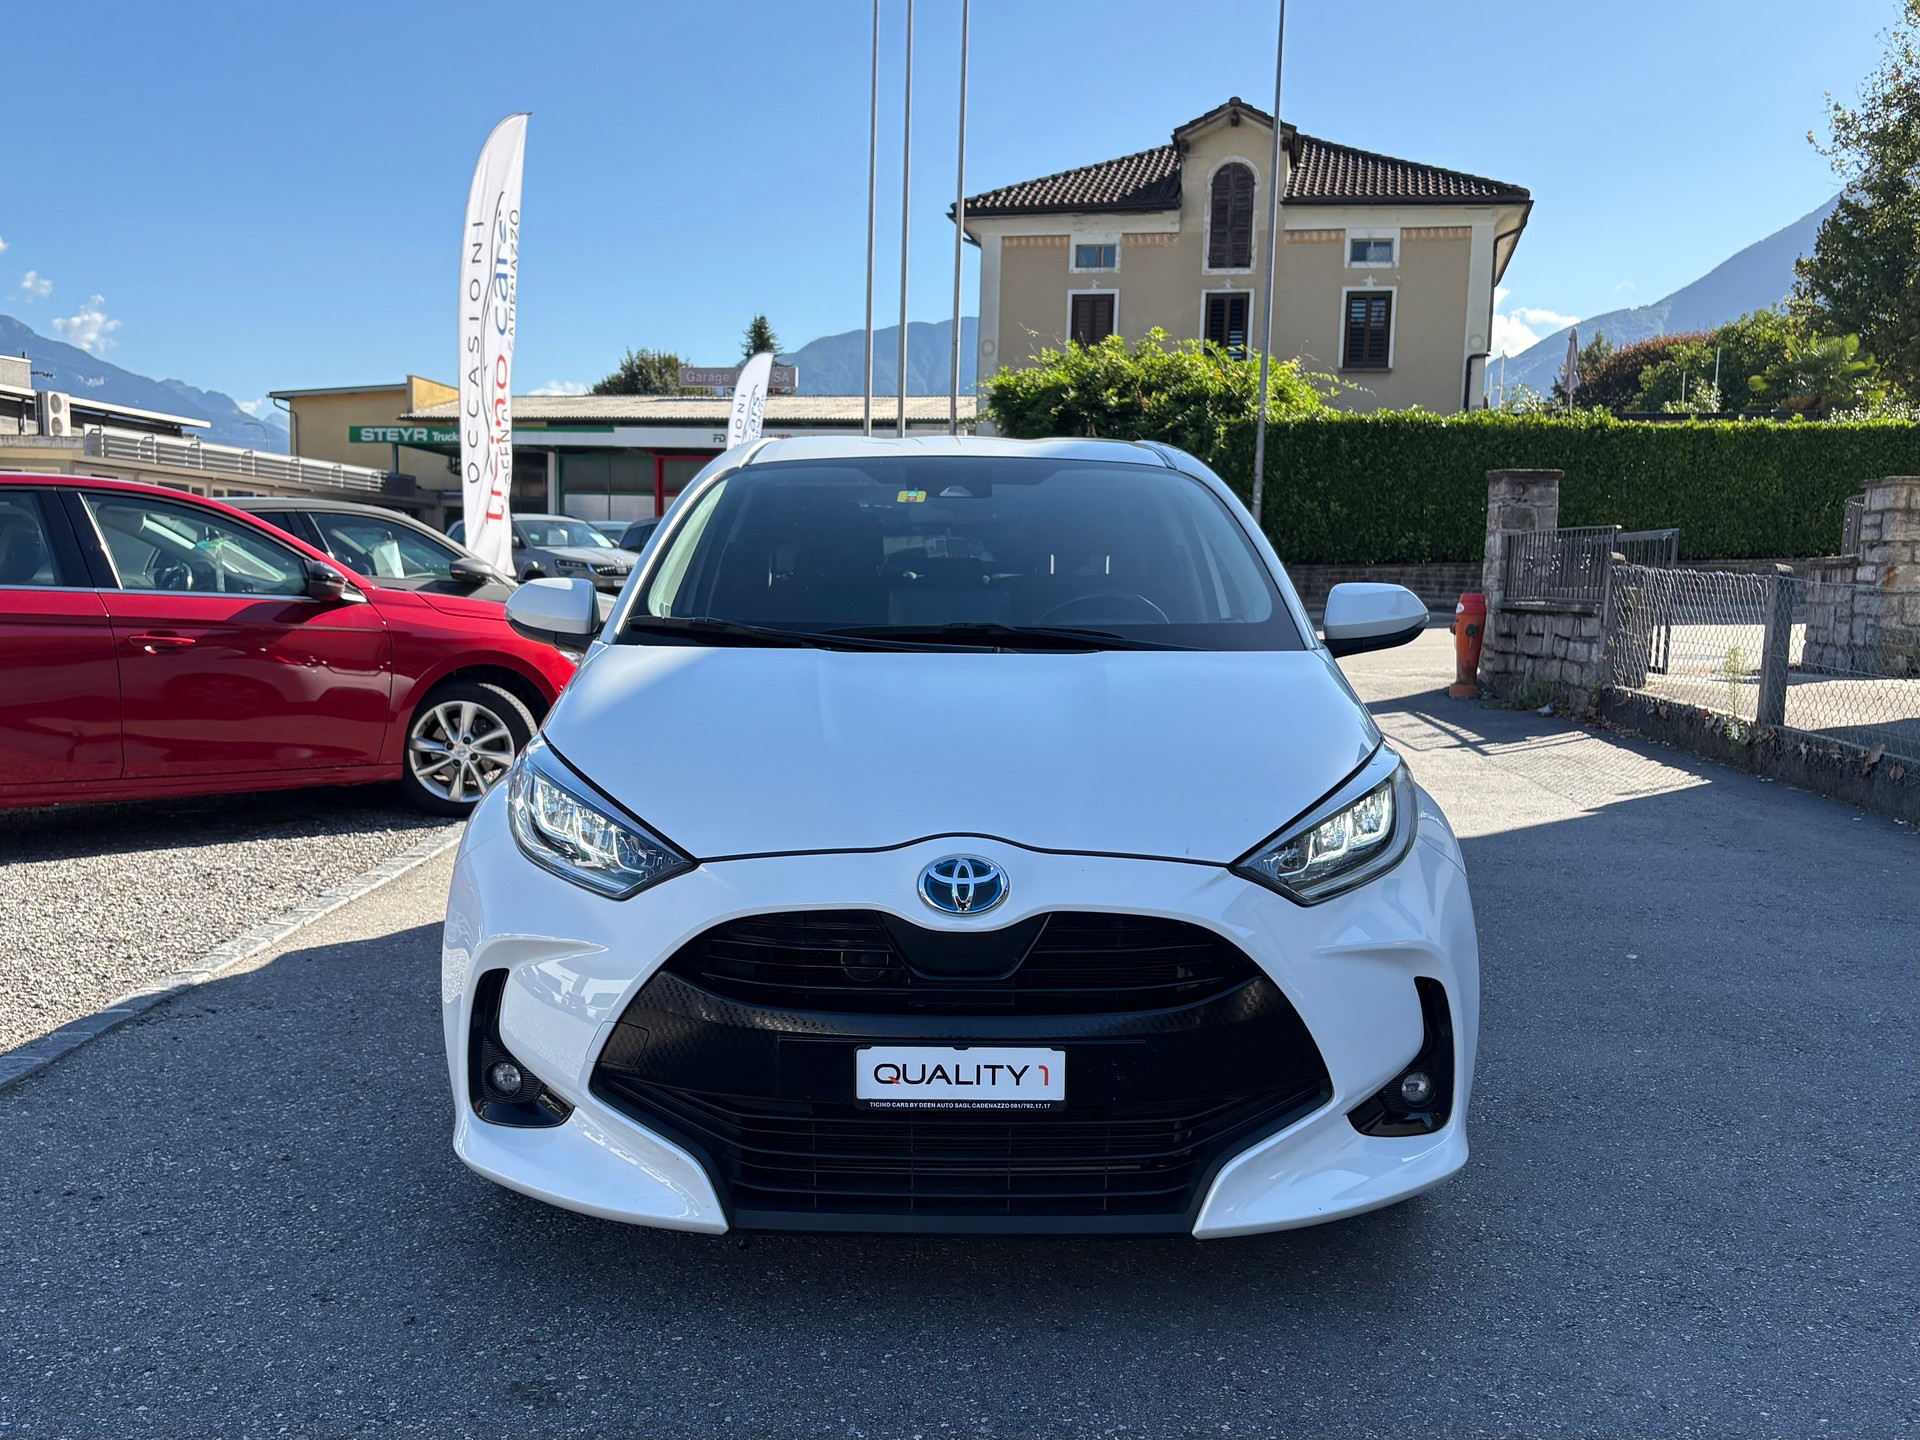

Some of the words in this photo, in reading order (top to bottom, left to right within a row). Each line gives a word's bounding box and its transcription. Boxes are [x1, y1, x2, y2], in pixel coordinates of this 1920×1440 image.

[467, 221, 485, 484] OCCASIONI
[685, 370, 730, 384] Garage
[772, 371, 790, 383] SA
[360, 427, 428, 442] STEYR
[873, 1063, 1030, 1086] QUALITY
[1038, 1064, 1049, 1086] 1
